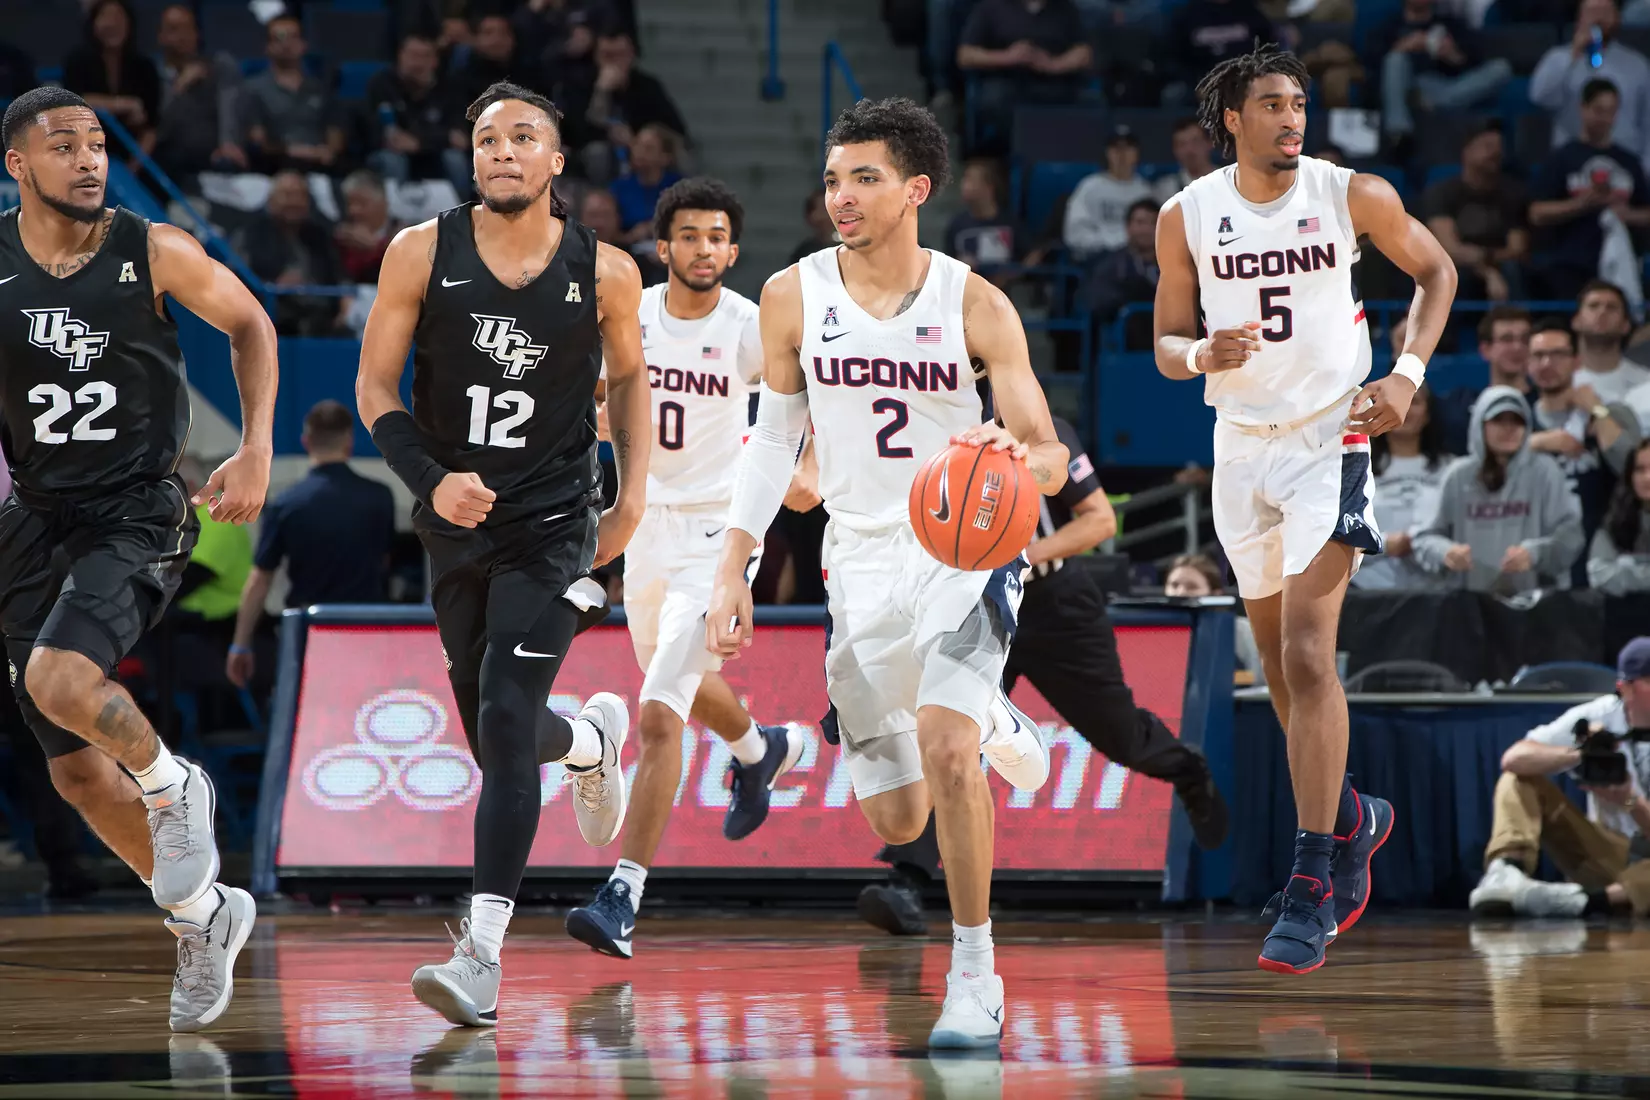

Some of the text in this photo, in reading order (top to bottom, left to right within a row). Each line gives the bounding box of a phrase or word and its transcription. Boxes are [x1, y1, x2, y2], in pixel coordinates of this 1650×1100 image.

[118, 261, 138, 283] A
[1211, 243, 1336, 280] UCONN
[565, 282, 582, 303] A
[1259, 286, 1293, 343] 5
[22, 308, 110, 371] UCF
[471, 314, 548, 380] UCF
[646, 365, 729, 397] CONN
[813, 356, 958, 392] UCONN
[28, 381, 117, 444] 22
[466, 384, 535, 448] 12
[658, 401, 685, 451] 0
[872, 397, 914, 459] 2
[973, 469, 1002, 531] ELITE
